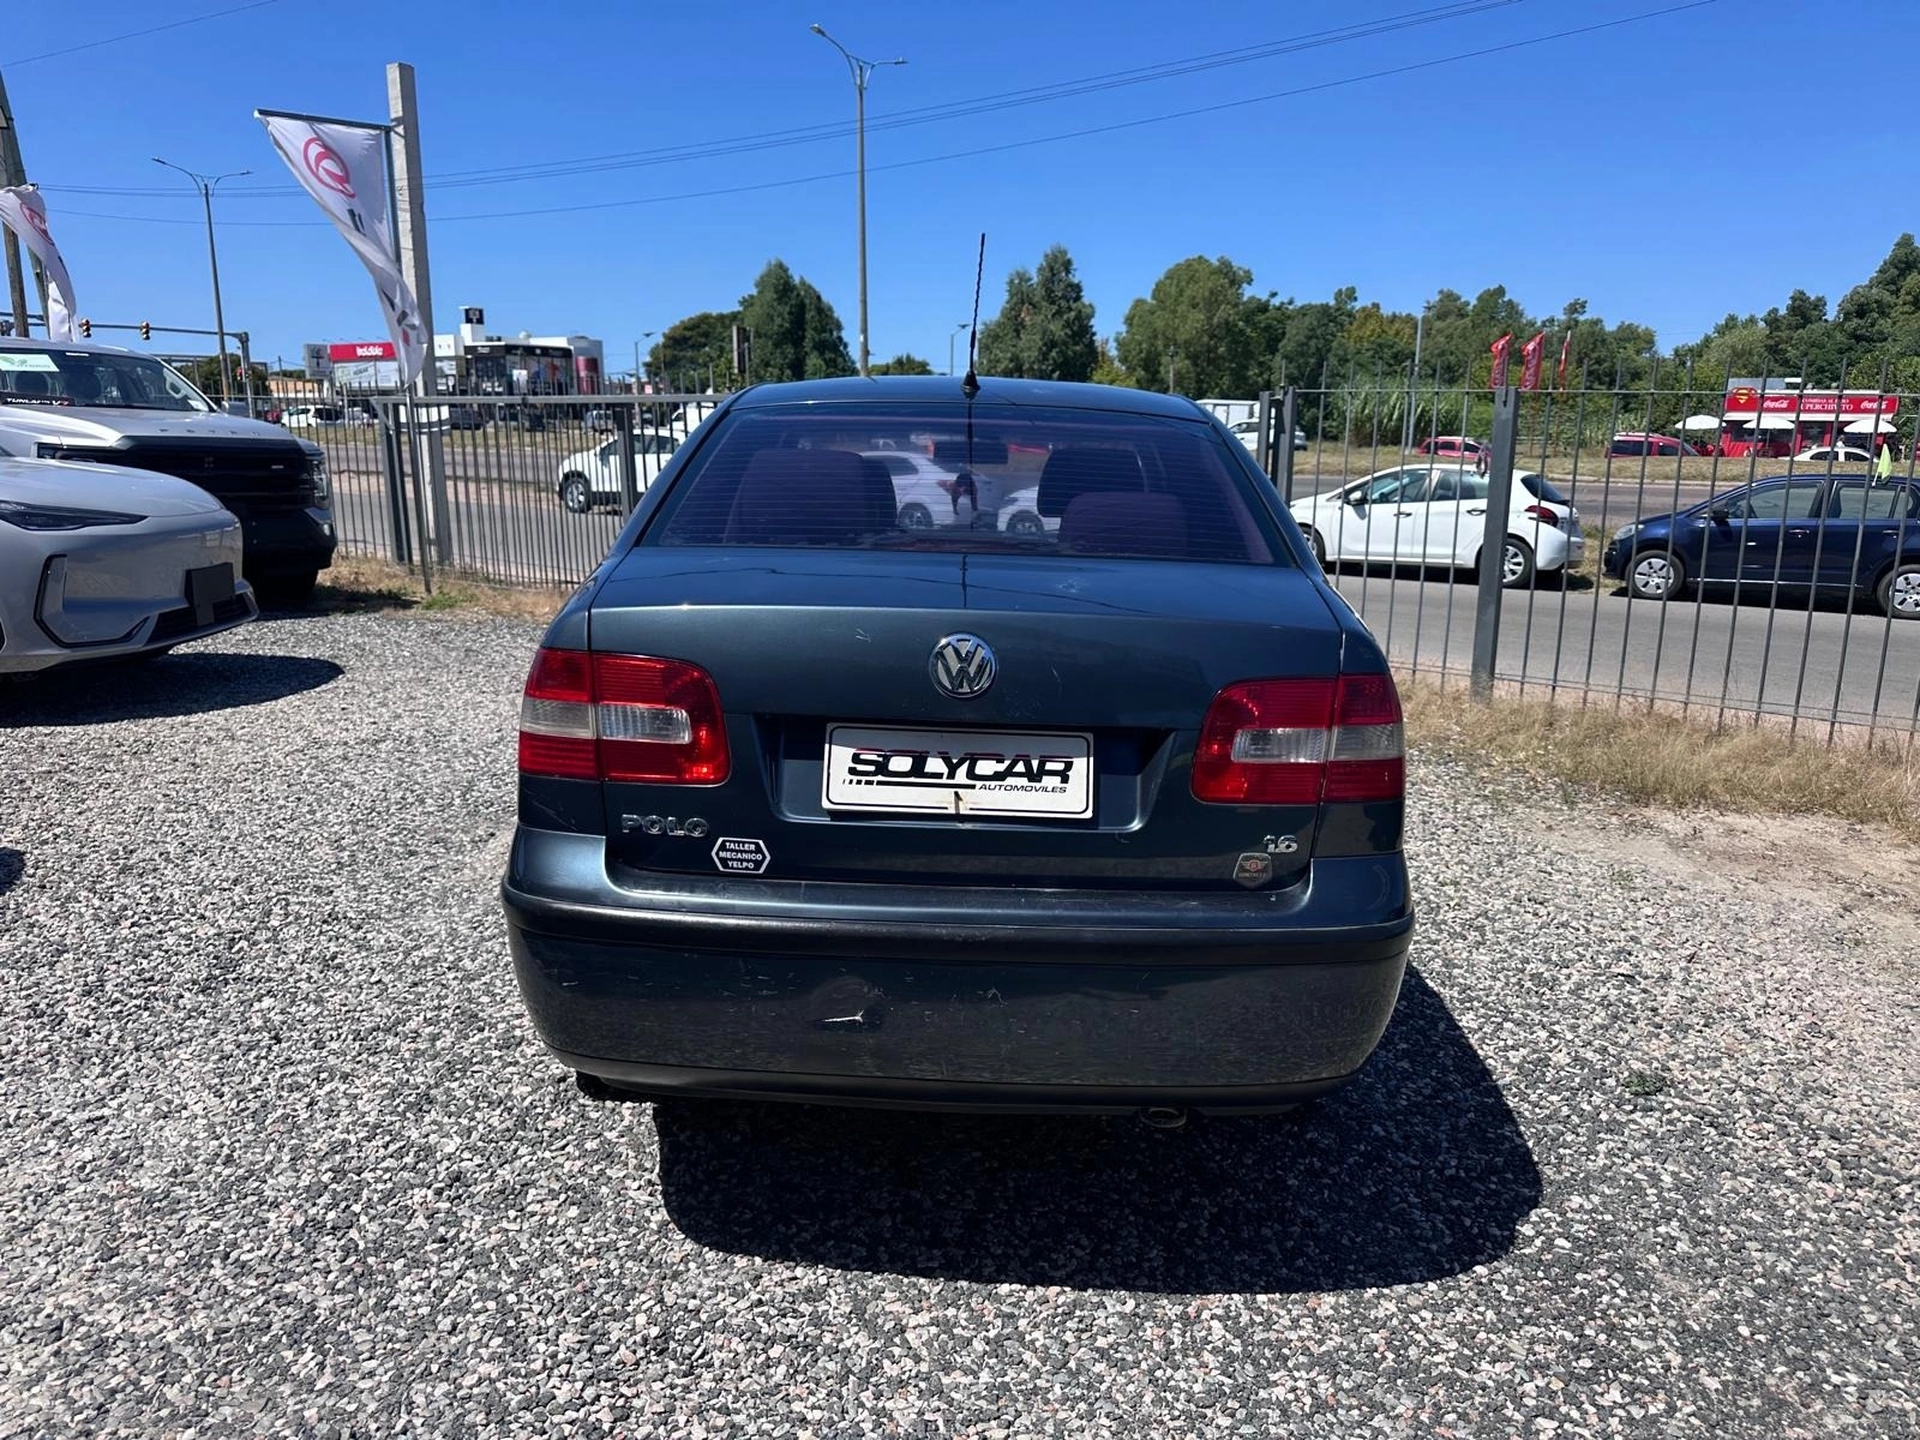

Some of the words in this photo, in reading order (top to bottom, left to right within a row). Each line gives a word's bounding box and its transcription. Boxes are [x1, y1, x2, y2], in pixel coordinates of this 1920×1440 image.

[848, 748, 1074, 784] SOLYCAR
[978, 783, 1068, 794] AUTOMOVILES
[620, 813, 710, 838] POLO
[725, 841, 756, 851] TALLER
[718, 850, 763, 861] MECANICO
[727, 860, 755, 869] YELPO
